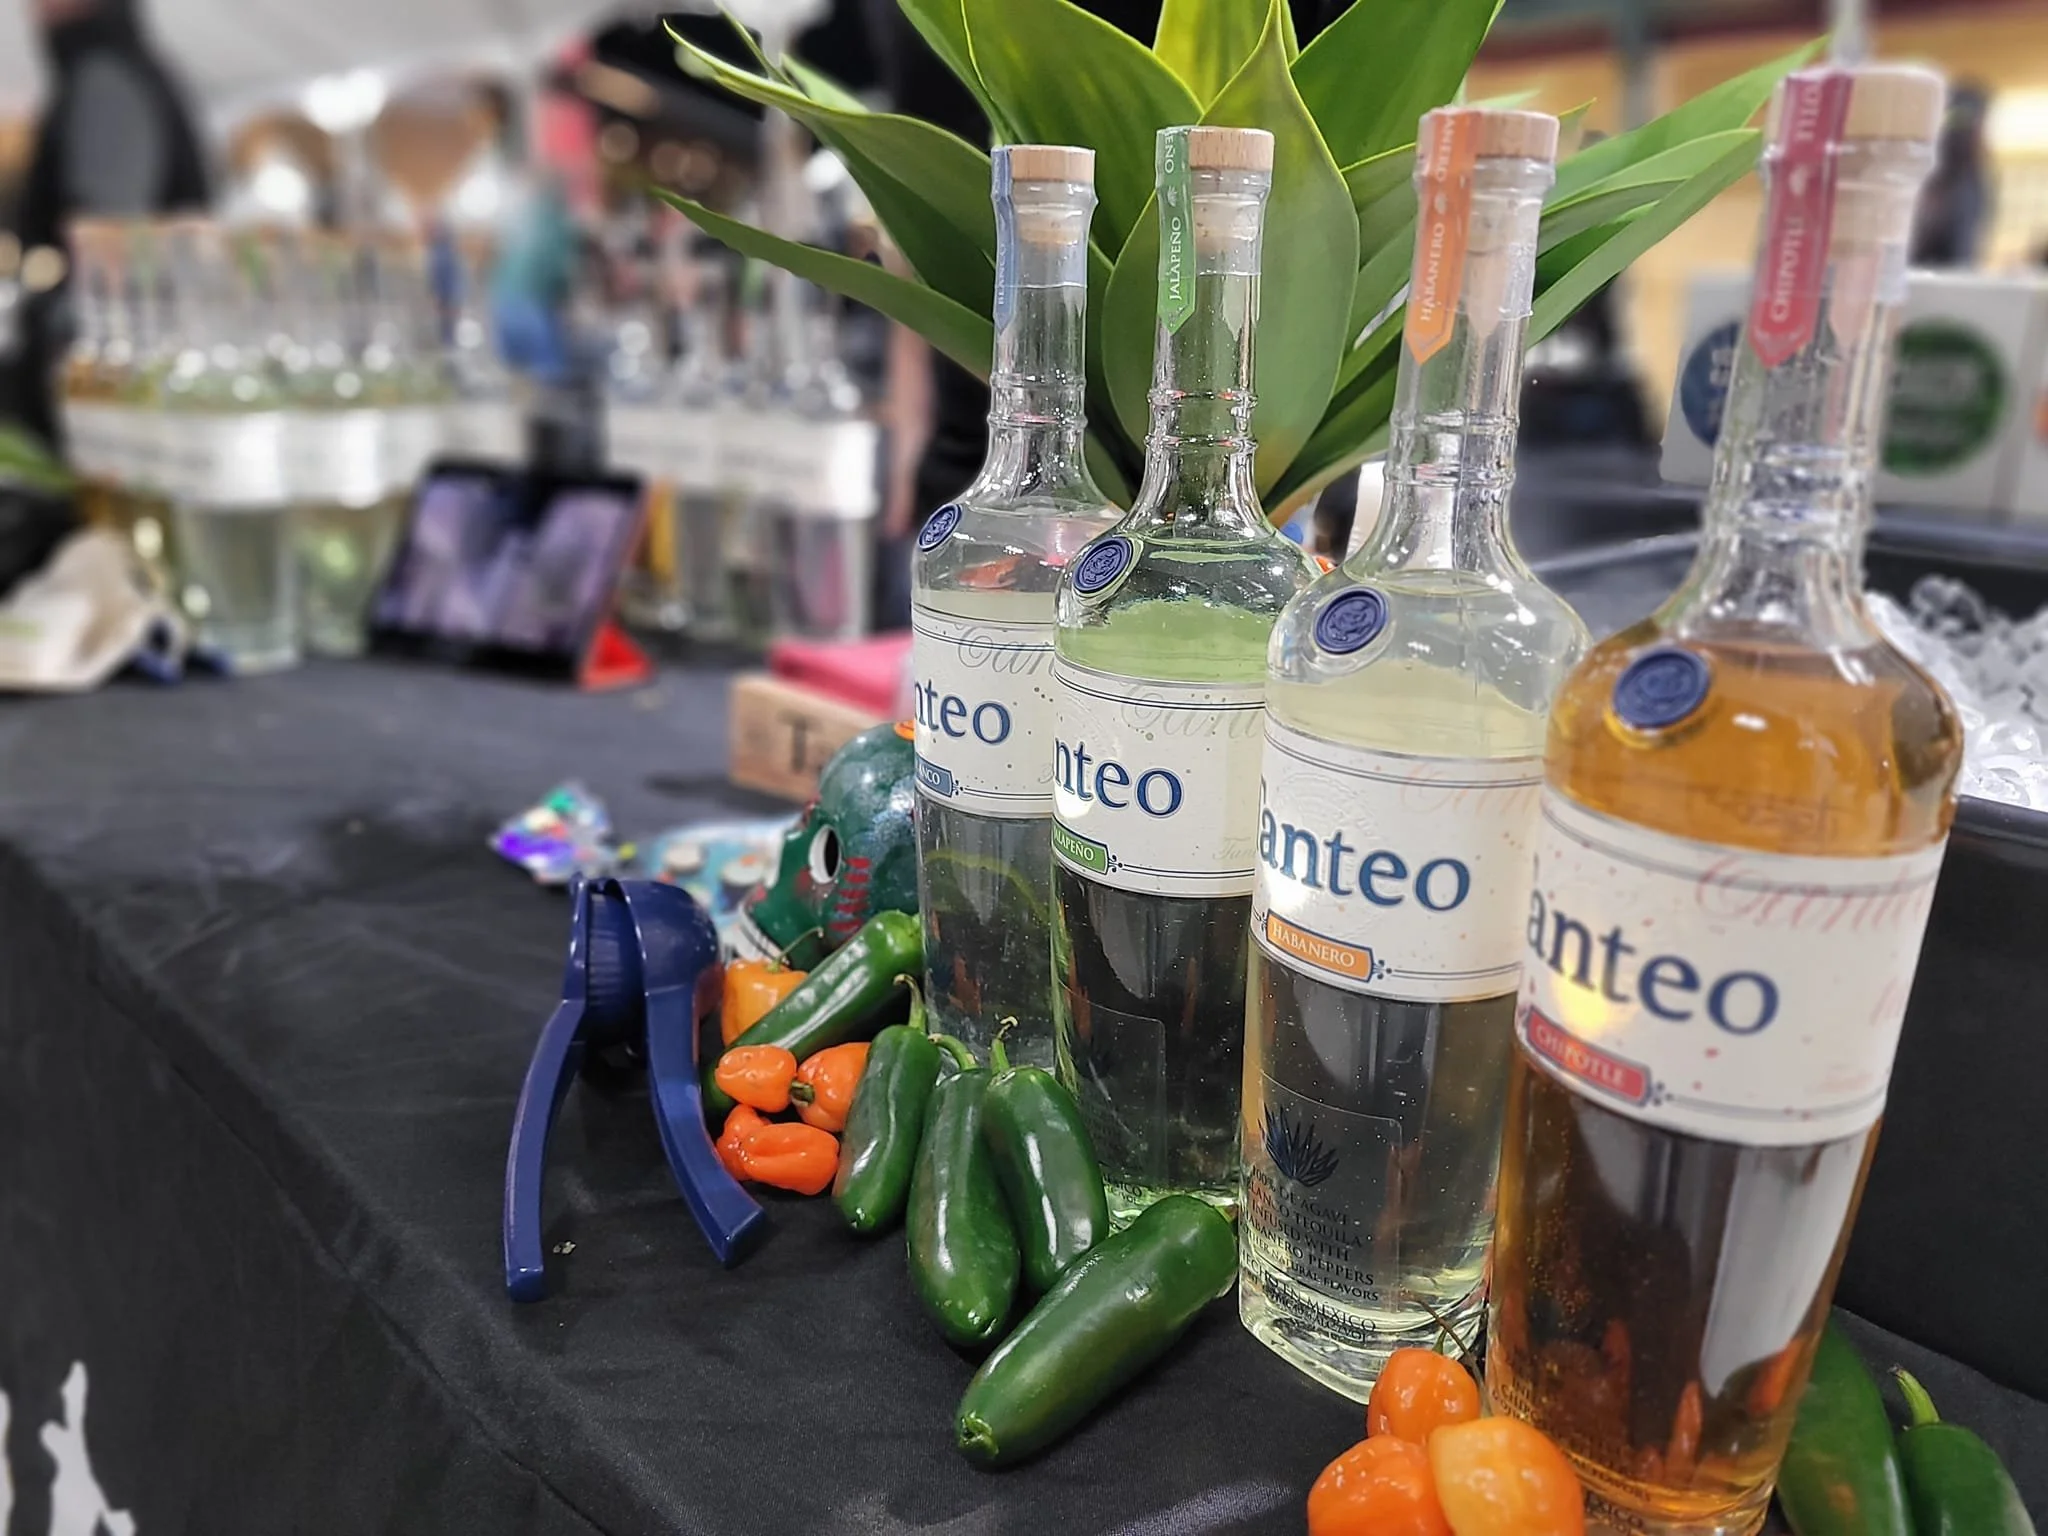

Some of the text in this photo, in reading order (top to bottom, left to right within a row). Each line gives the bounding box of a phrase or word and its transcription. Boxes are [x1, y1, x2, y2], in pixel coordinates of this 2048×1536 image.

[998, 243, 1007, 305] BLANCO
[1169, 216, 1182, 301] JALAPEÑO
[1421, 222, 1446, 322] HABANERO
[1055, 737, 1182, 816] nteo
[1259, 776, 1471, 911] anteo
[1272, 922, 1355, 967] HABANERO
[1527, 853, 1781, 1036] anteo
[1536, 1022, 1627, 1087] CHIPOTLE
[1249, 1179, 1290, 1218] LANCO
[1304, 1234, 1349, 1262] WITH
[1308, 1254, 1374, 1287] PEPPERS
[1324, 1276, 1379, 1301] FLAVORS
